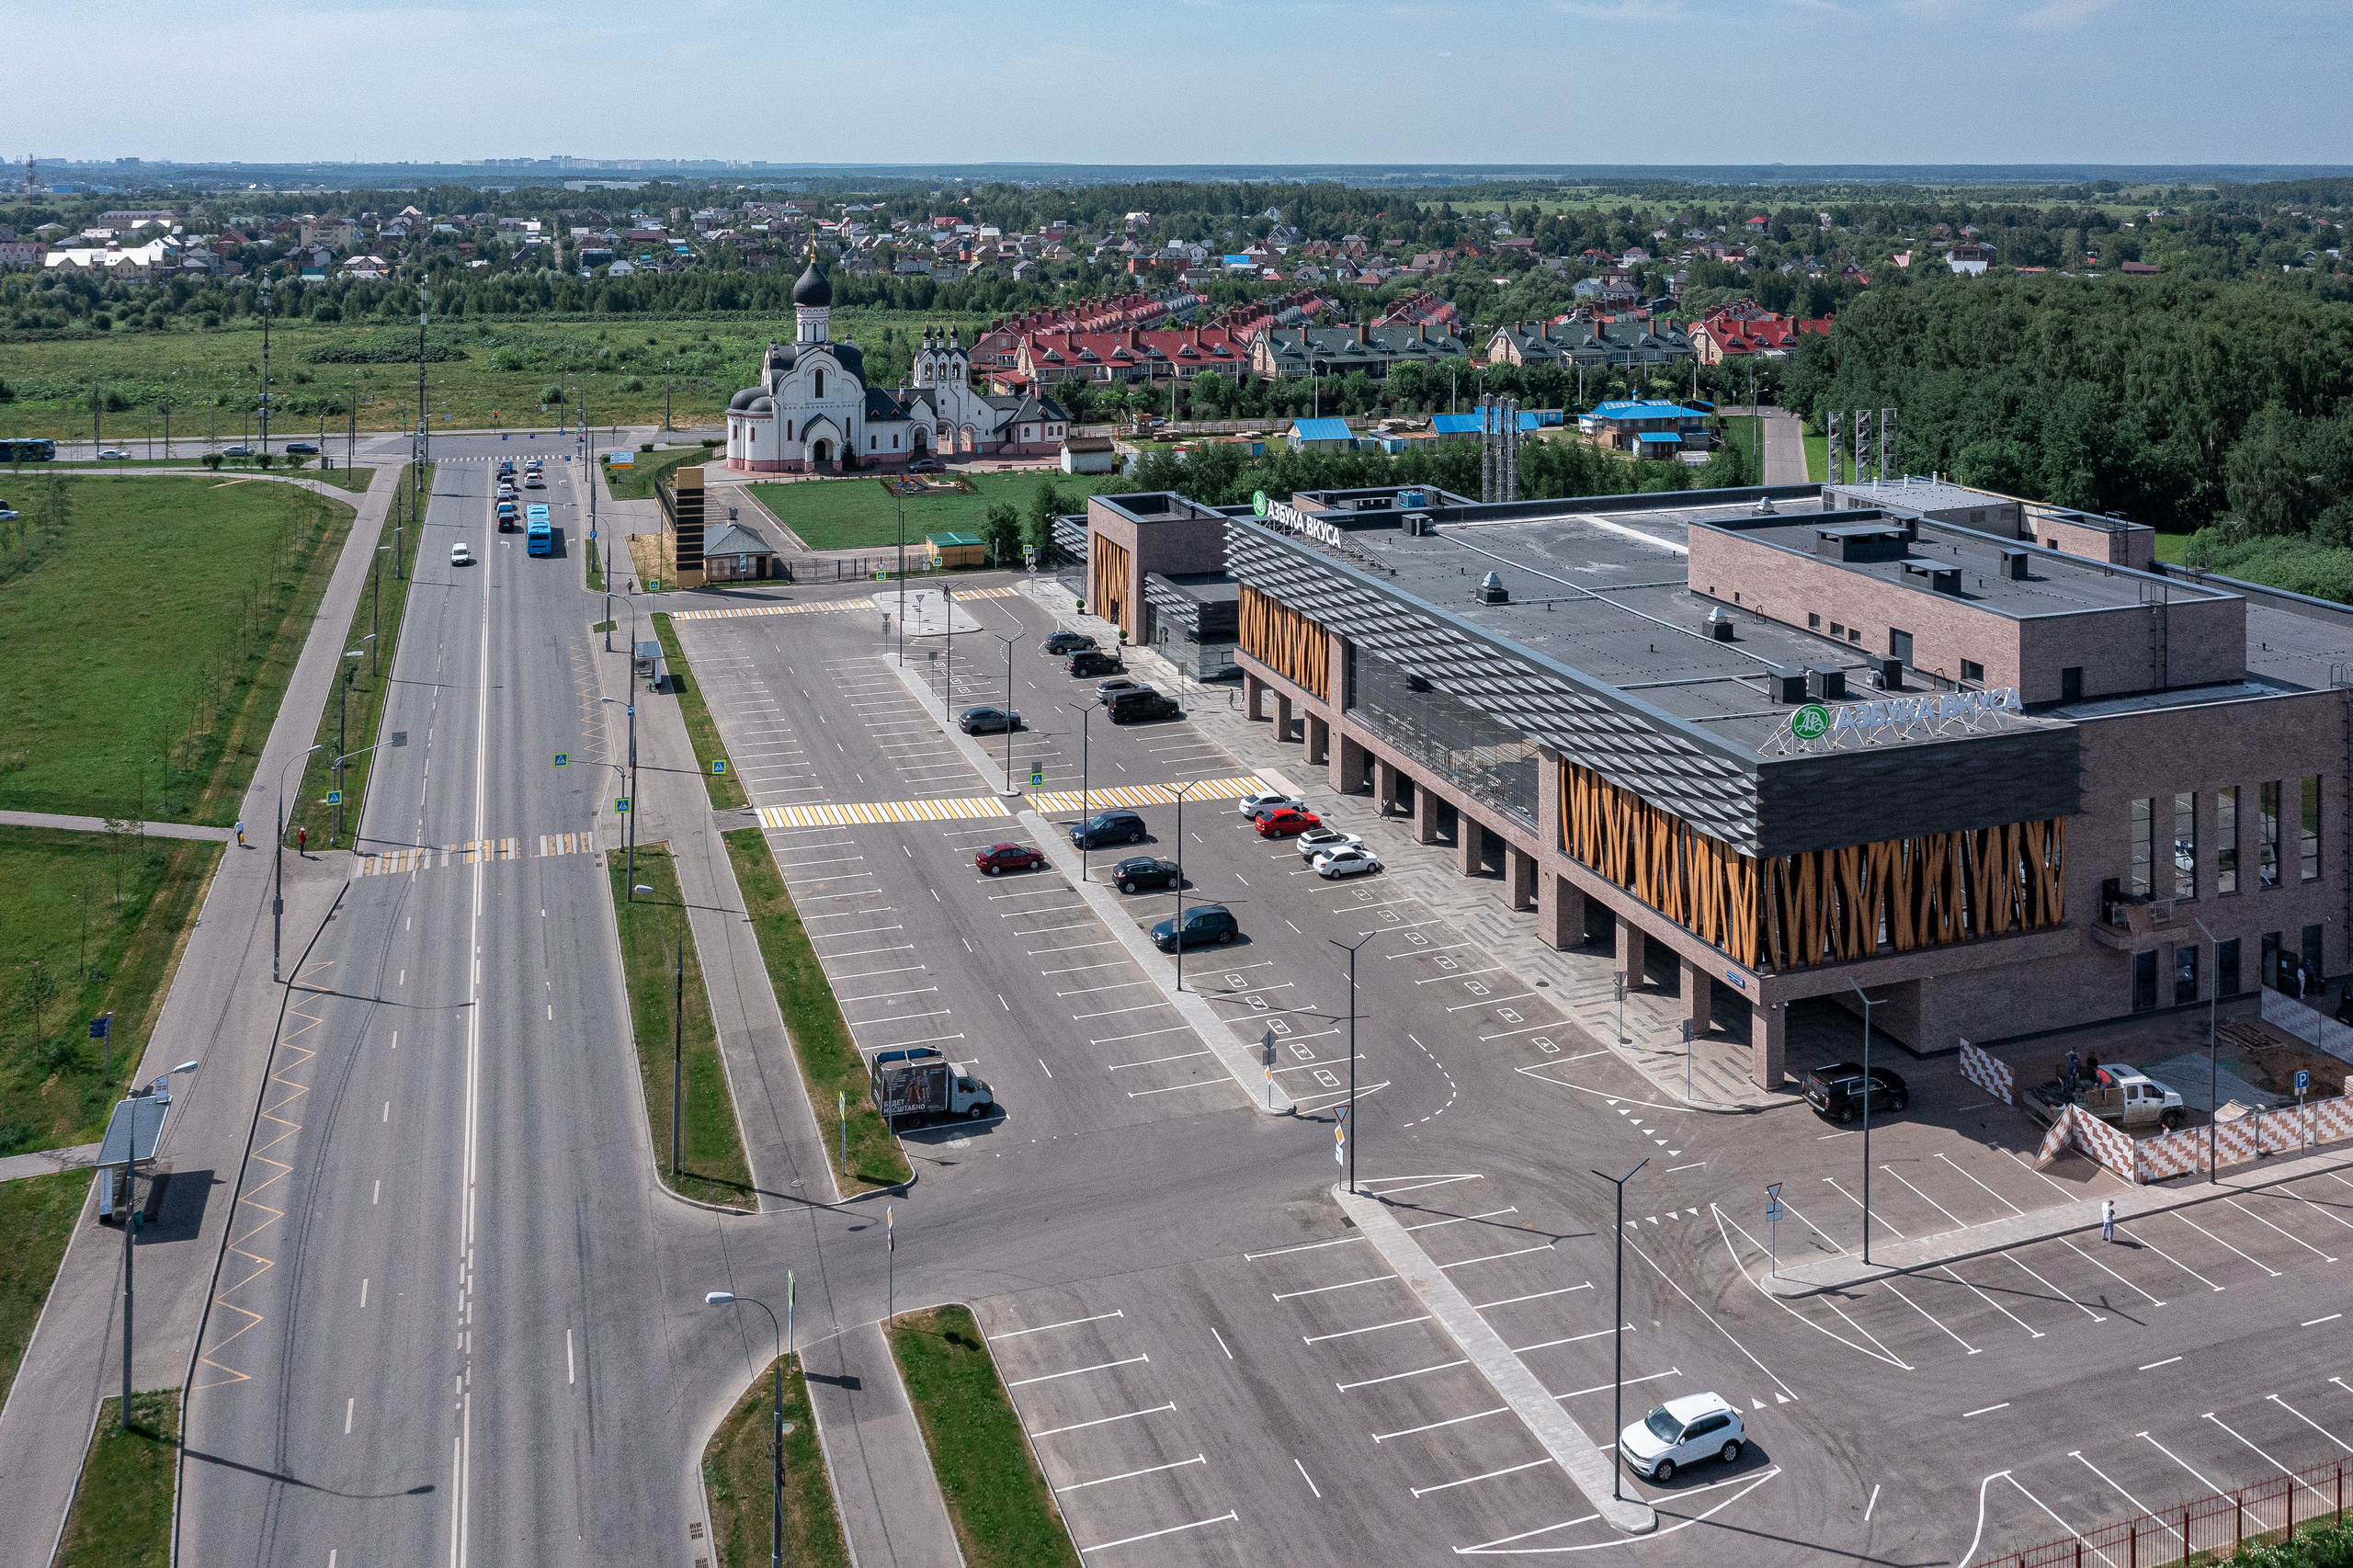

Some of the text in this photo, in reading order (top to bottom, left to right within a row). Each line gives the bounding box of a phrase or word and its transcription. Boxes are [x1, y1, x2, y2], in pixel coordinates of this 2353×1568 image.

[1267, 499, 1305, 533] АЗБУКА
[1306, 516, 1342, 549] ВКУСА
[1834, 687, 2023, 732] АЗБУКА ВКУСА
[2300, 1074, 2307, 1086] P
